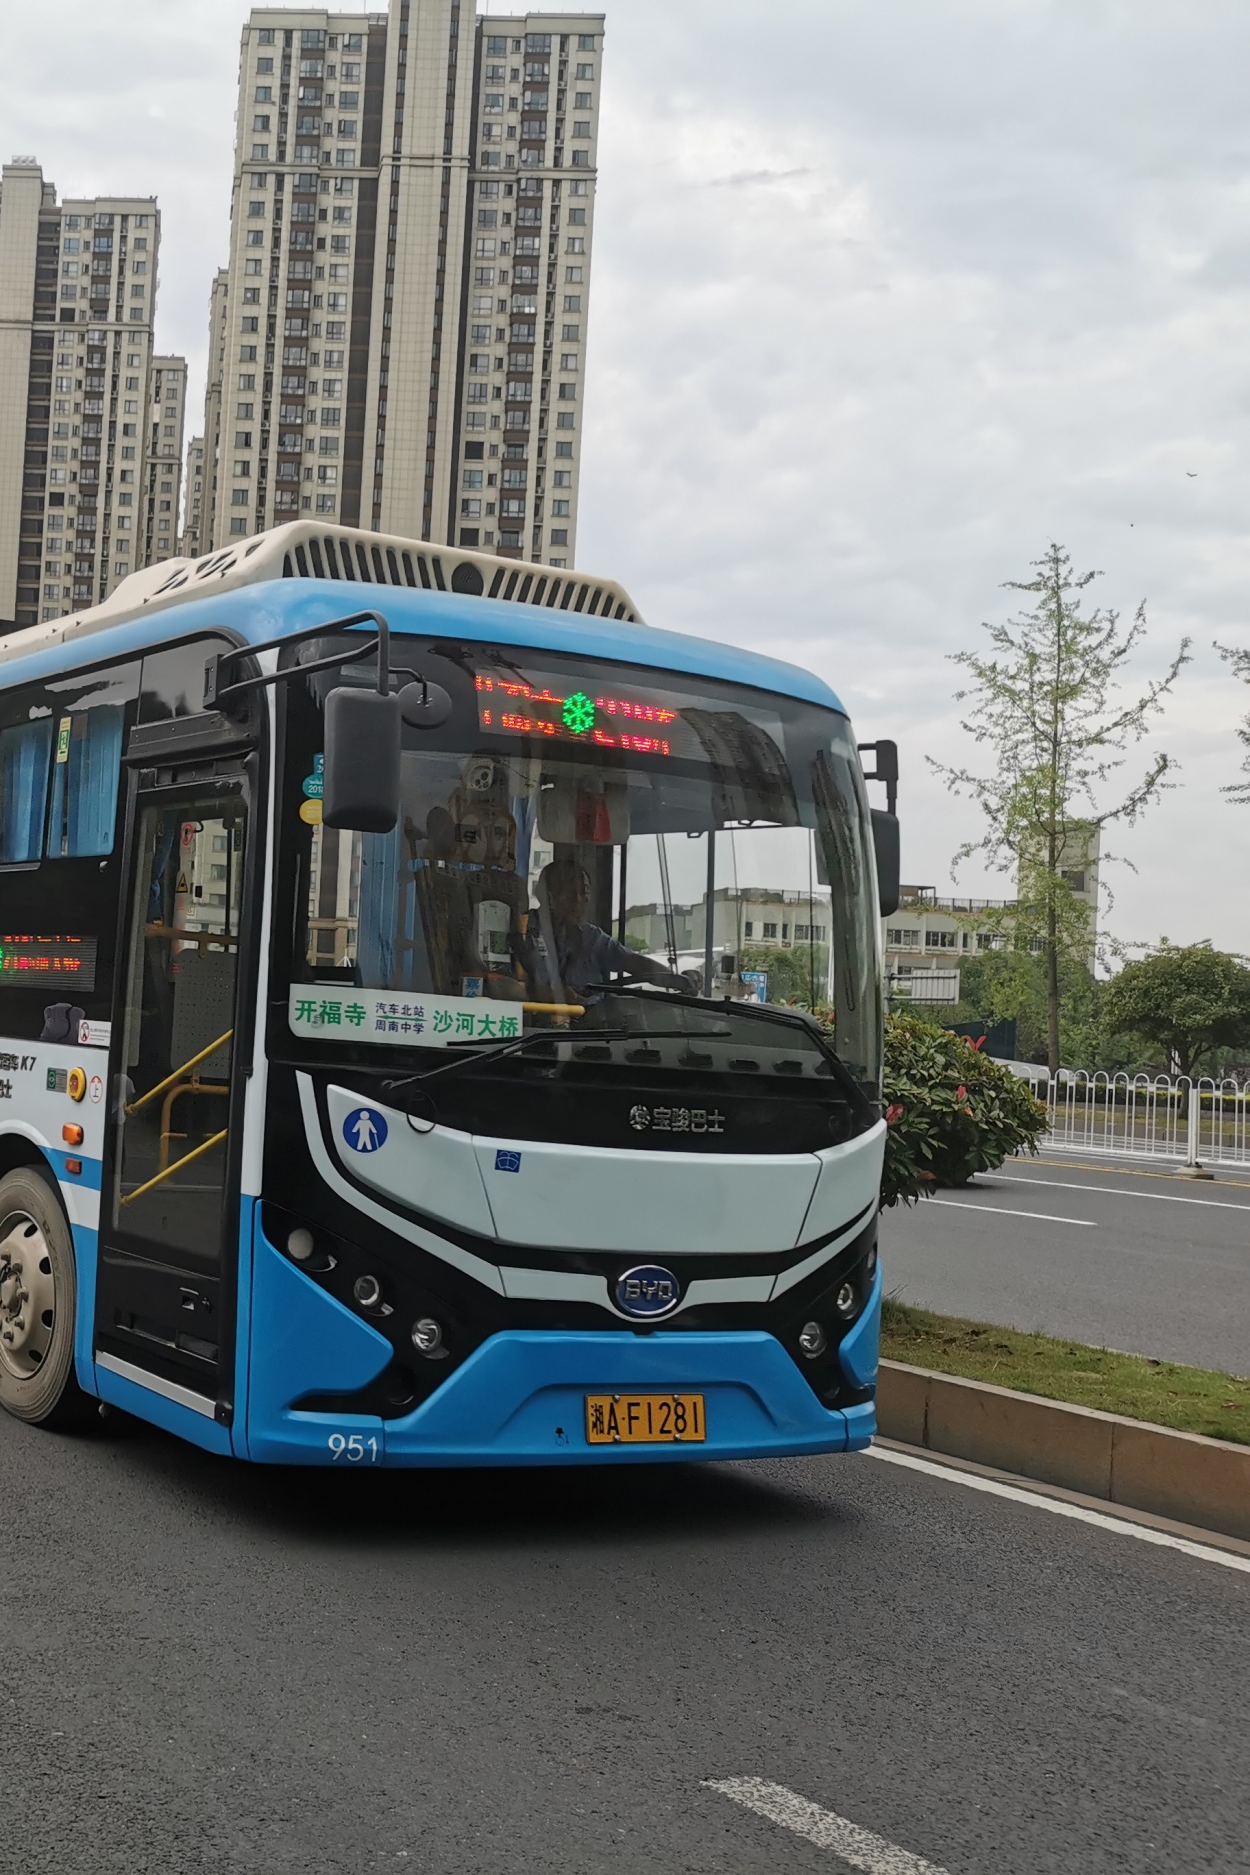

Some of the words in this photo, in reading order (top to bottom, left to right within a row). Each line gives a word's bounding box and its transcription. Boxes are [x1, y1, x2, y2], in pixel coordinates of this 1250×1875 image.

[295, 999, 367, 1026] 开福寺
[375, 1002, 425, 1018] 汽车北站
[374, 1020, 425, 1035] 周南中学
[432, 1010, 519, 1037] 沙河大桥
[20, 1056, 37, 1071] K7
[652, 1107, 726, 1132] 宝骏巴士
[625, 1280, 672, 1300] BYD
[328, 1433, 377, 1462] 951
